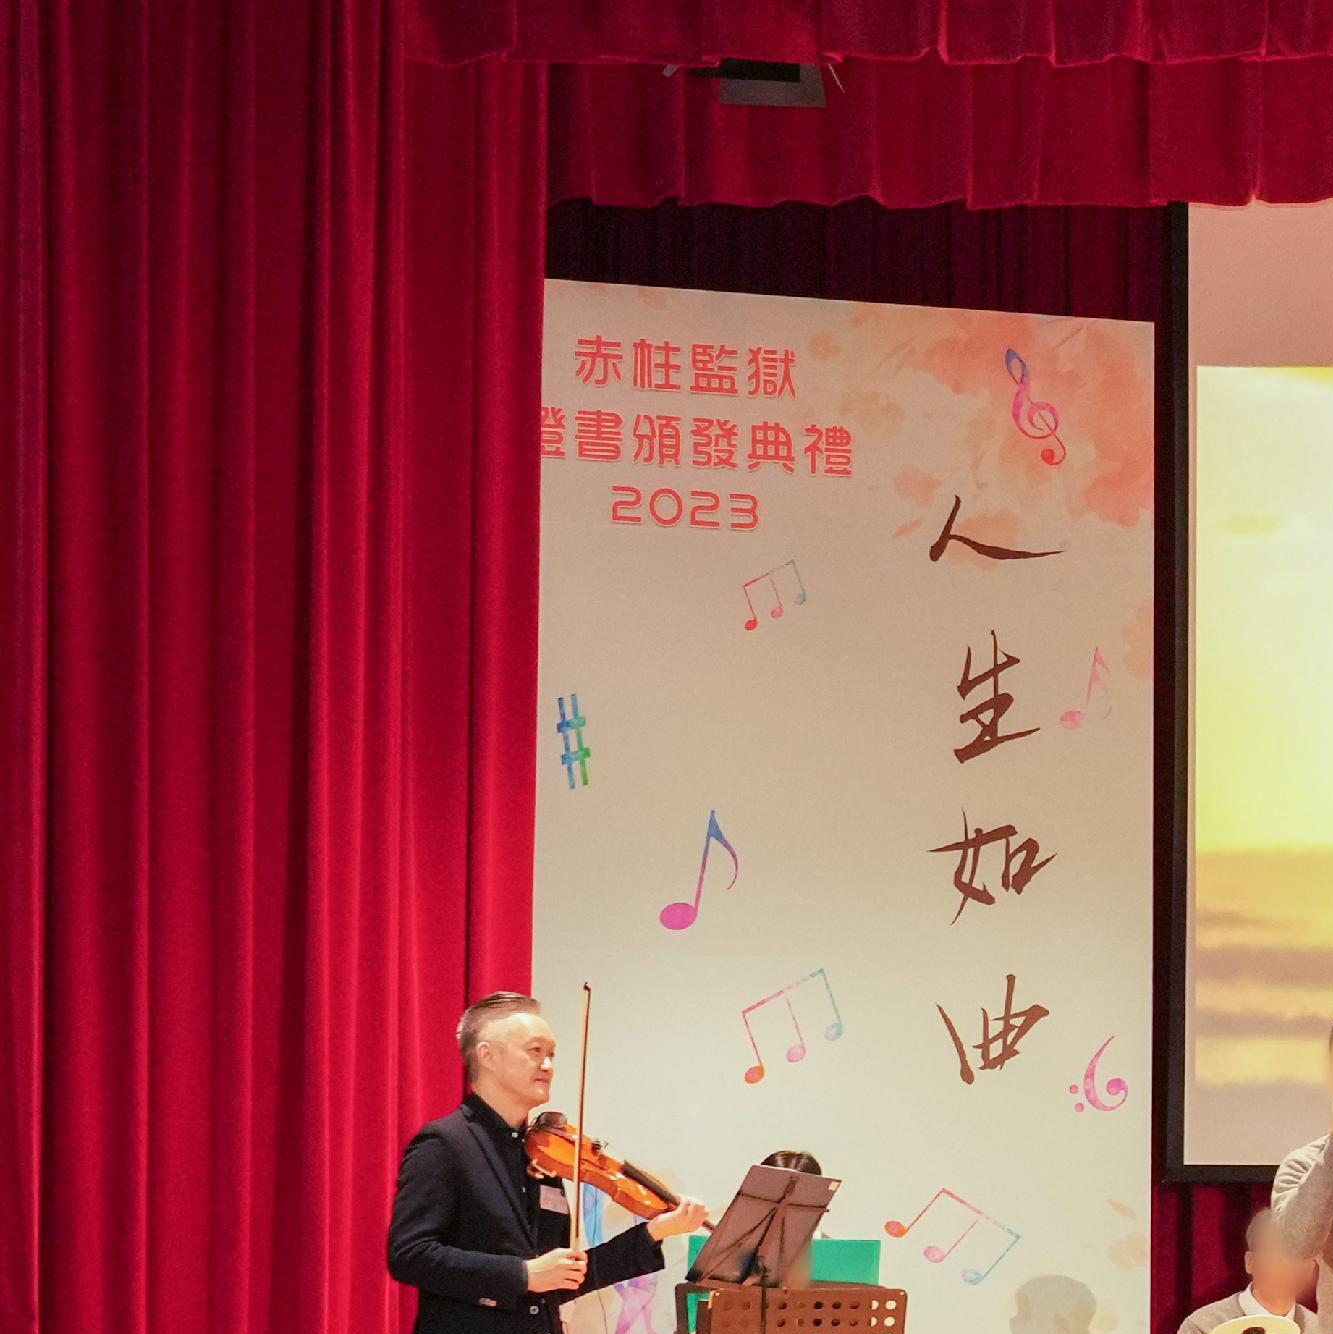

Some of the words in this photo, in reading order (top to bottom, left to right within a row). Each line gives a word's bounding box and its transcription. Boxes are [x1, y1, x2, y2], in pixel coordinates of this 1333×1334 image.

[573, 335, 797, 398] 赤柱監獄
[610, 485, 760, 530] 2023
[927, 494, 1067, 1085] 人生如曲
